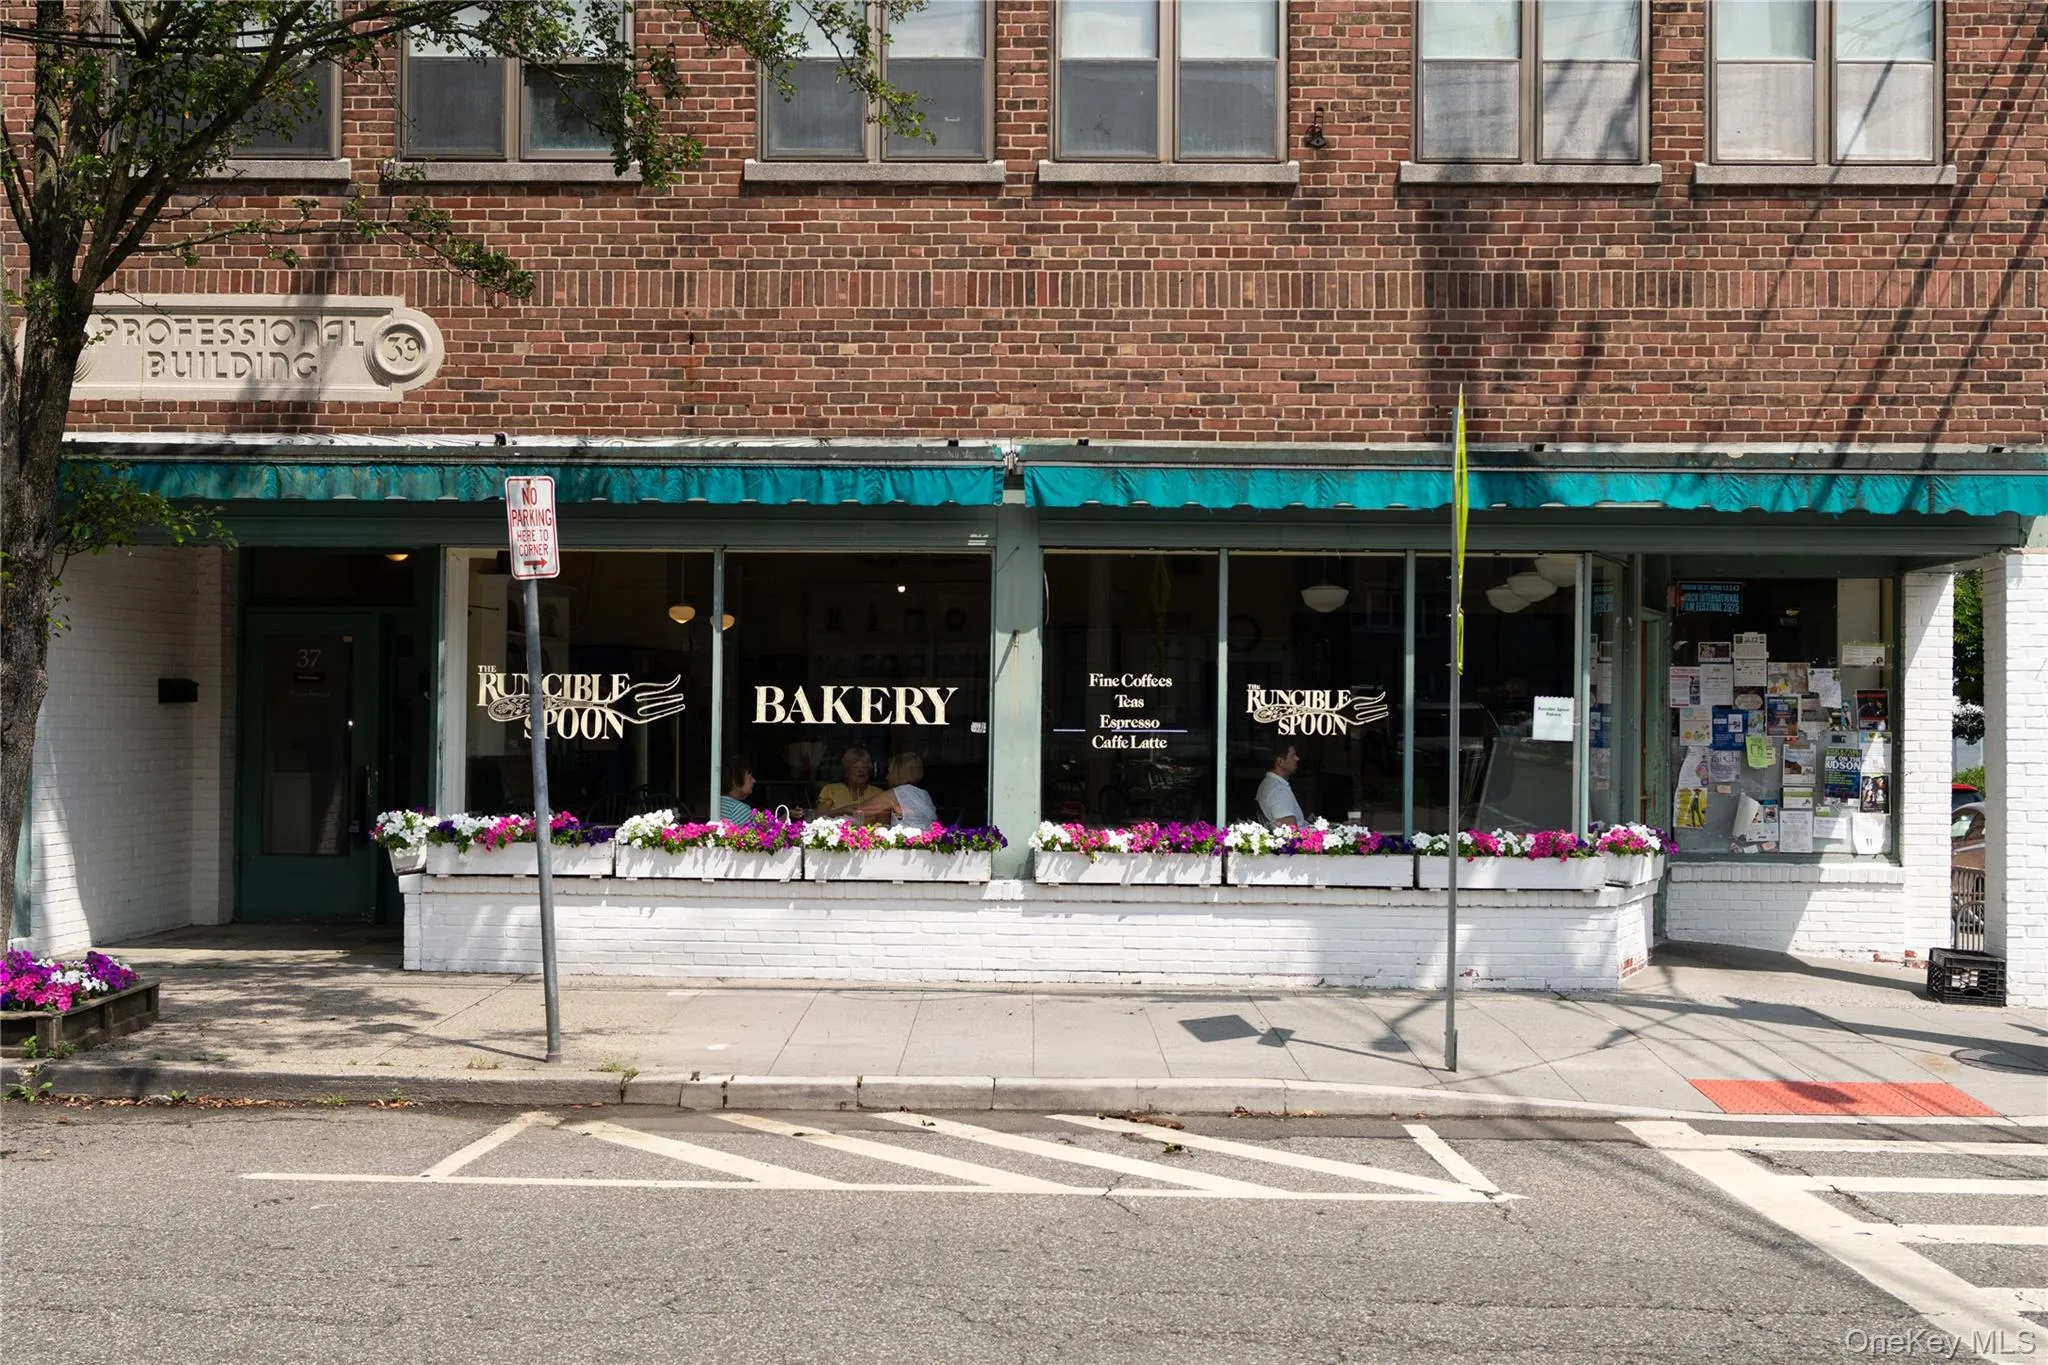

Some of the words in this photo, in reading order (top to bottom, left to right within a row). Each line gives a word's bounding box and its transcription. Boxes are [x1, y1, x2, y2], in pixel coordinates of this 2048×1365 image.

[100, 318, 364, 347] PROFESSIONAL
[387, 336, 422, 362] 39
[147, 350, 319, 379] BUILDING
[522, 488, 537, 505] NO
[512, 509, 552, 526] PARKING
[517, 530, 536, 541] HERE
[540, 529, 549, 541] TO
[519, 544, 549, 557] CORNER
[298, 648, 321, 667] 37
[478, 665, 496, 673] THE
[1089, 673, 1120, 687] Fine
[1121, 673, 1173, 688] Coffees
[752, 685, 959, 725] BAKERY
[1115, 694, 1145, 708] Teas
[1245, 689, 1351, 713] RUNCIBLE
[1100, 714, 1160, 730] Espresso
[1278, 713, 1348, 736] SPOON
[1092, 735, 1129, 749] Caffe
[1130, 735, 1168, 749] Latte
